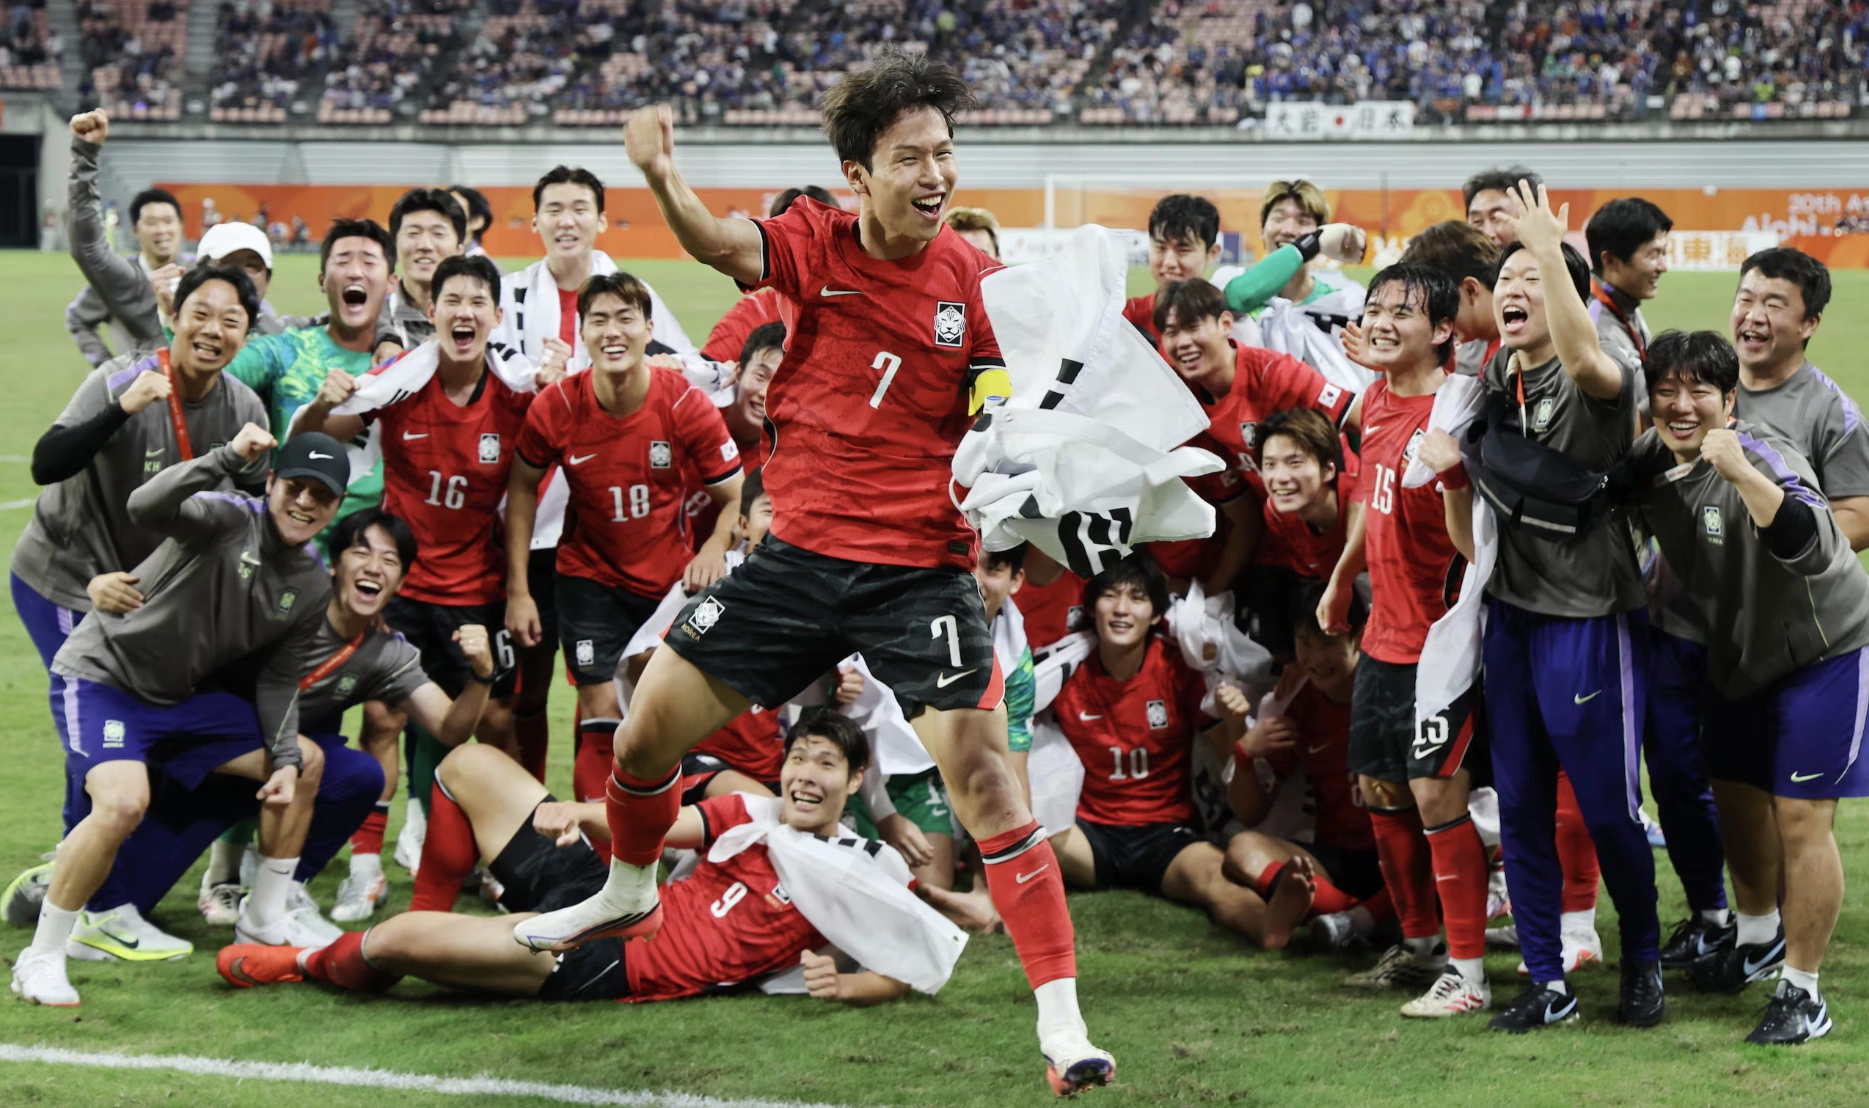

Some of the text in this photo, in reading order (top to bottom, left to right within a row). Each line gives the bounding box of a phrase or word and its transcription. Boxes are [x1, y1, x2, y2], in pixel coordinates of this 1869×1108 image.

[1787, 193, 1842, 214] 20th
[869, 350, 902, 410] 7
[143, 460, 161, 472] KH
[424, 470, 468, 510] 16
[608, 484, 650, 522] 18
[1371, 463, 1396, 515] 15
[681, 622, 701, 642] KOREA
[930, 614, 964, 668] 7
[1108, 746, 1149, 780] 10
[710, 881, 748, 918] 9
